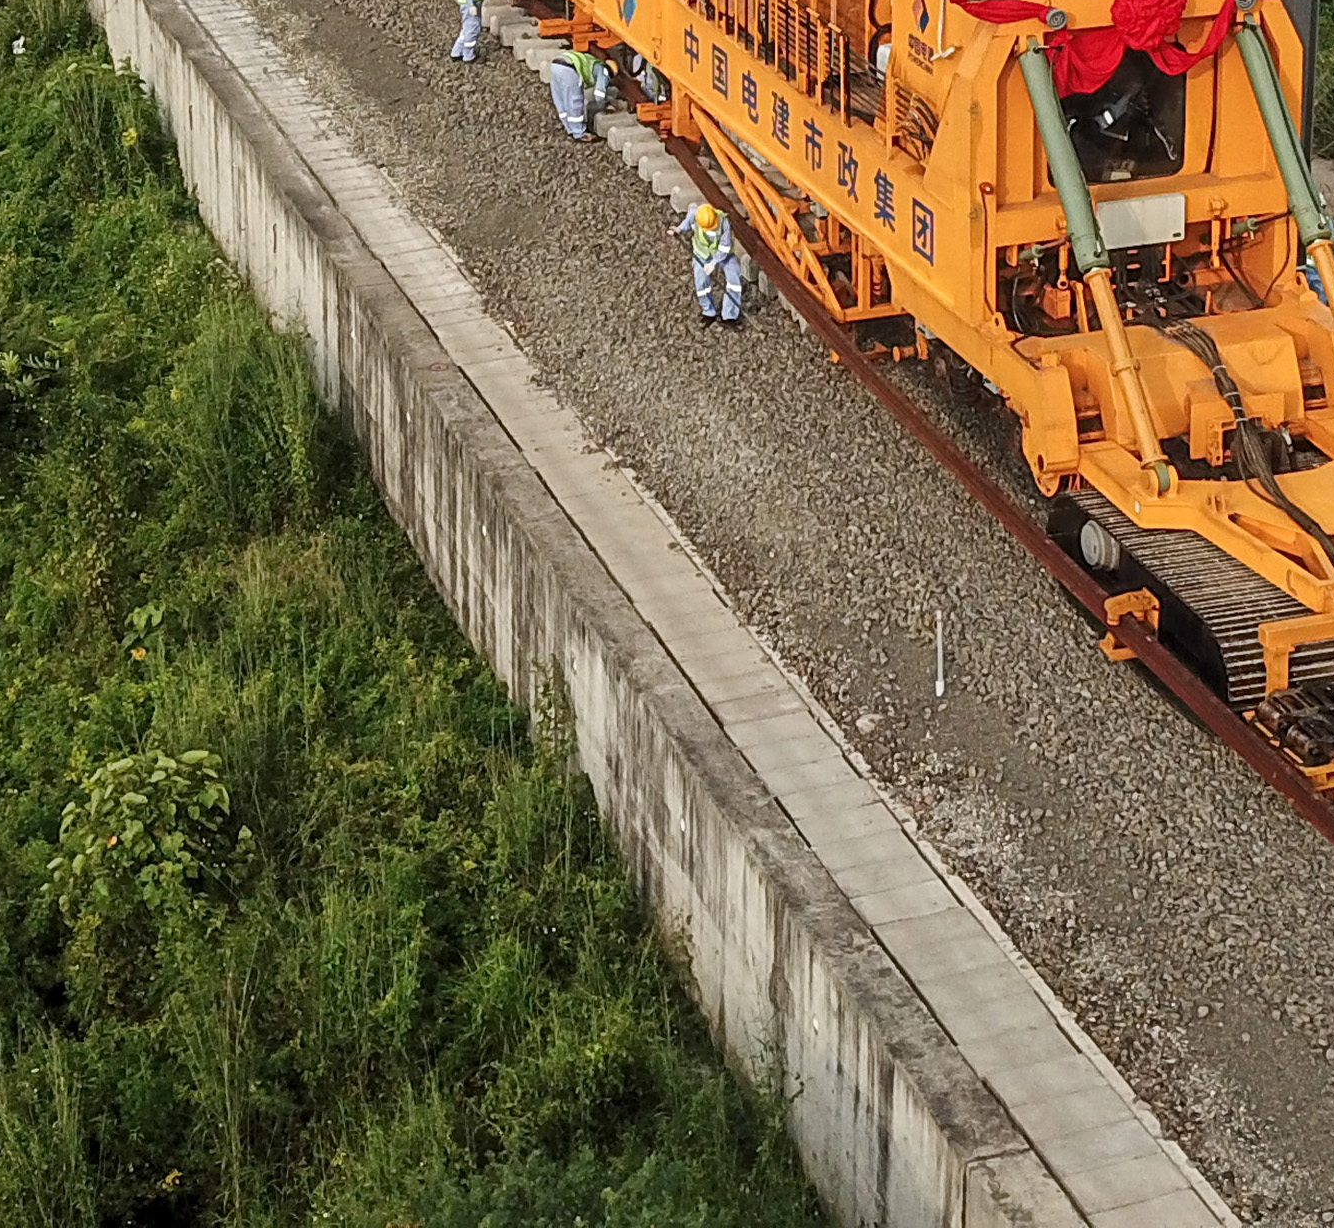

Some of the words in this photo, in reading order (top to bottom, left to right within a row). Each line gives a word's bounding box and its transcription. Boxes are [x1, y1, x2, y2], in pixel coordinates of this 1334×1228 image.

[683, 23, 937, 268] 中国电建市政集团
